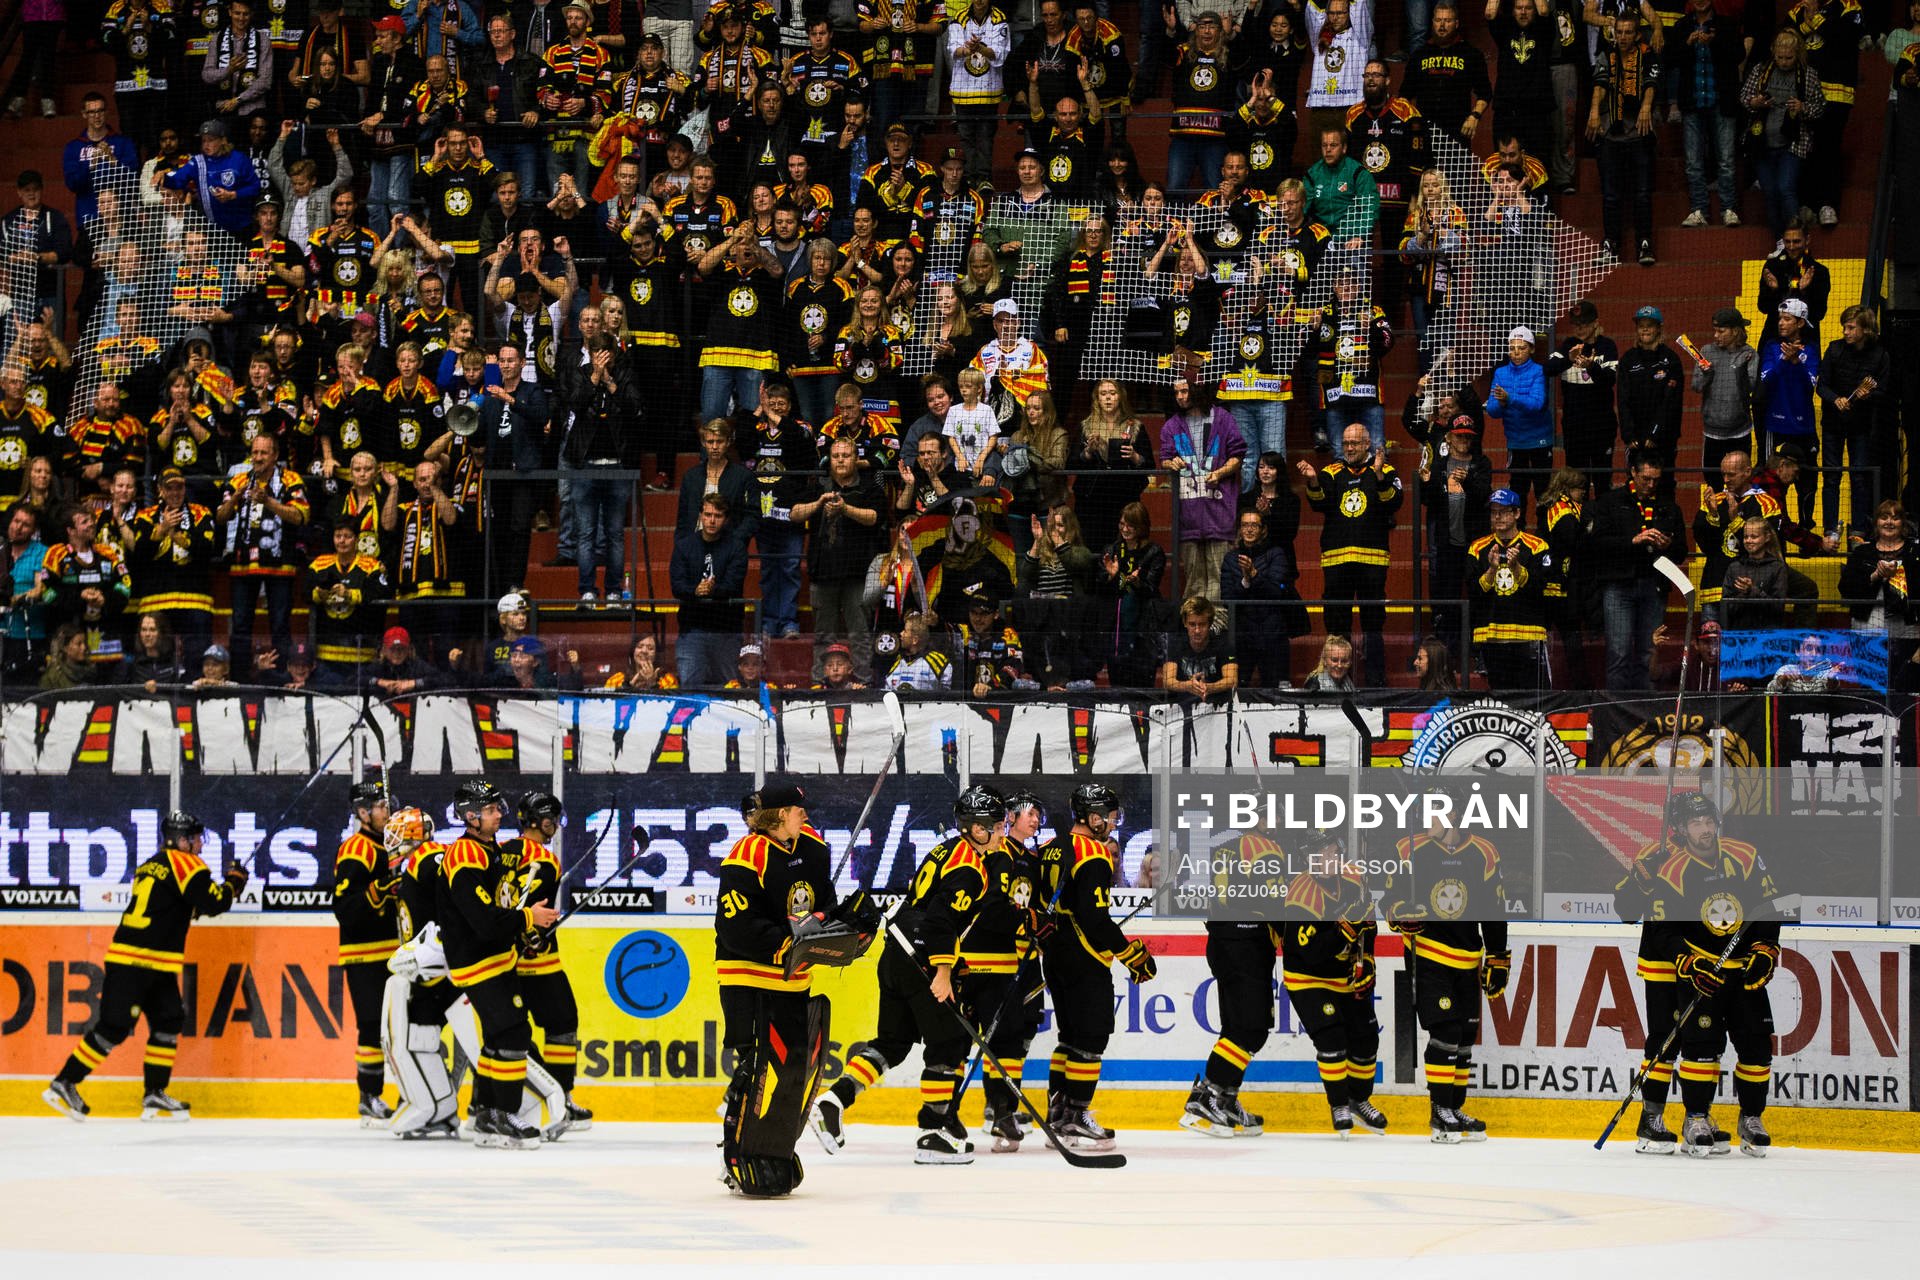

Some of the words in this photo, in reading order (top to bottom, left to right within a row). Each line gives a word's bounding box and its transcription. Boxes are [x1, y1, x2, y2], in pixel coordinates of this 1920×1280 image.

[1421, 55, 1465, 71] BRYNÄS
[494, 646, 510, 660] 92
[1654, 714, 1704, 734] 1912
[1790, 712, 1901, 754] 12
[585, 807, 752, 888] 153
[2, 889, 79, 905] VOLVIA
[265, 891, 333, 906] VOLVI
[572, 892, 653, 908] VOLVIA
[720, 888, 749, 919] 30
[1574, 901, 1610, 914] THAI
[1829, 905, 1863, 918] THAI
